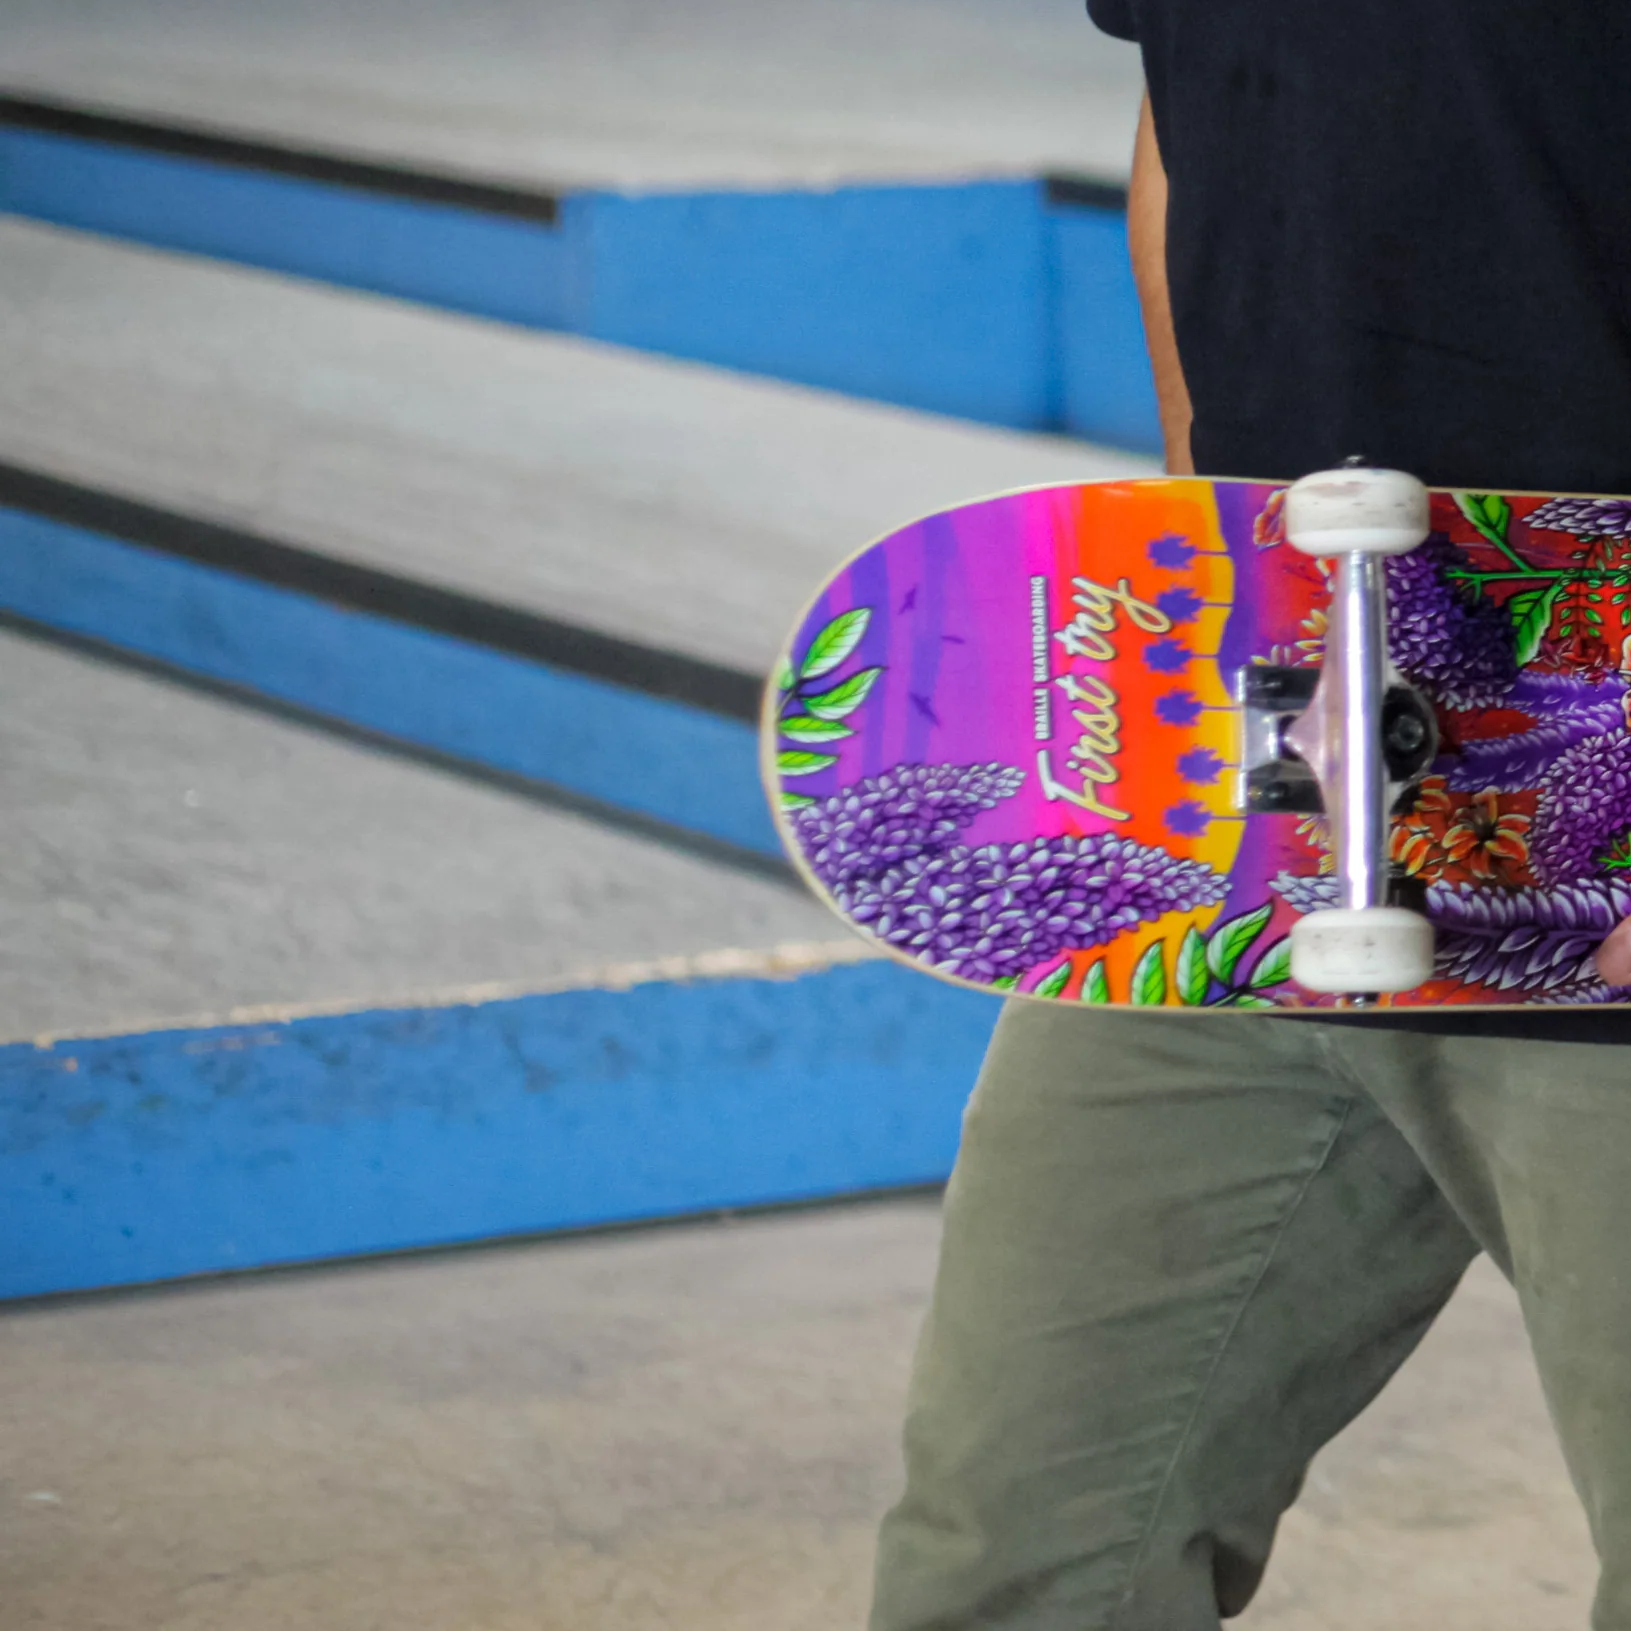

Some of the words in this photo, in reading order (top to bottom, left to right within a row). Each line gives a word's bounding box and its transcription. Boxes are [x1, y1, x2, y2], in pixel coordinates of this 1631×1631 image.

[1030, 575, 1049, 683] SKATEBOARDING
[1053, 577, 1172, 661] try
[1033, 687, 1051, 740] BRAILLE
[1037, 674, 1131, 821] First
